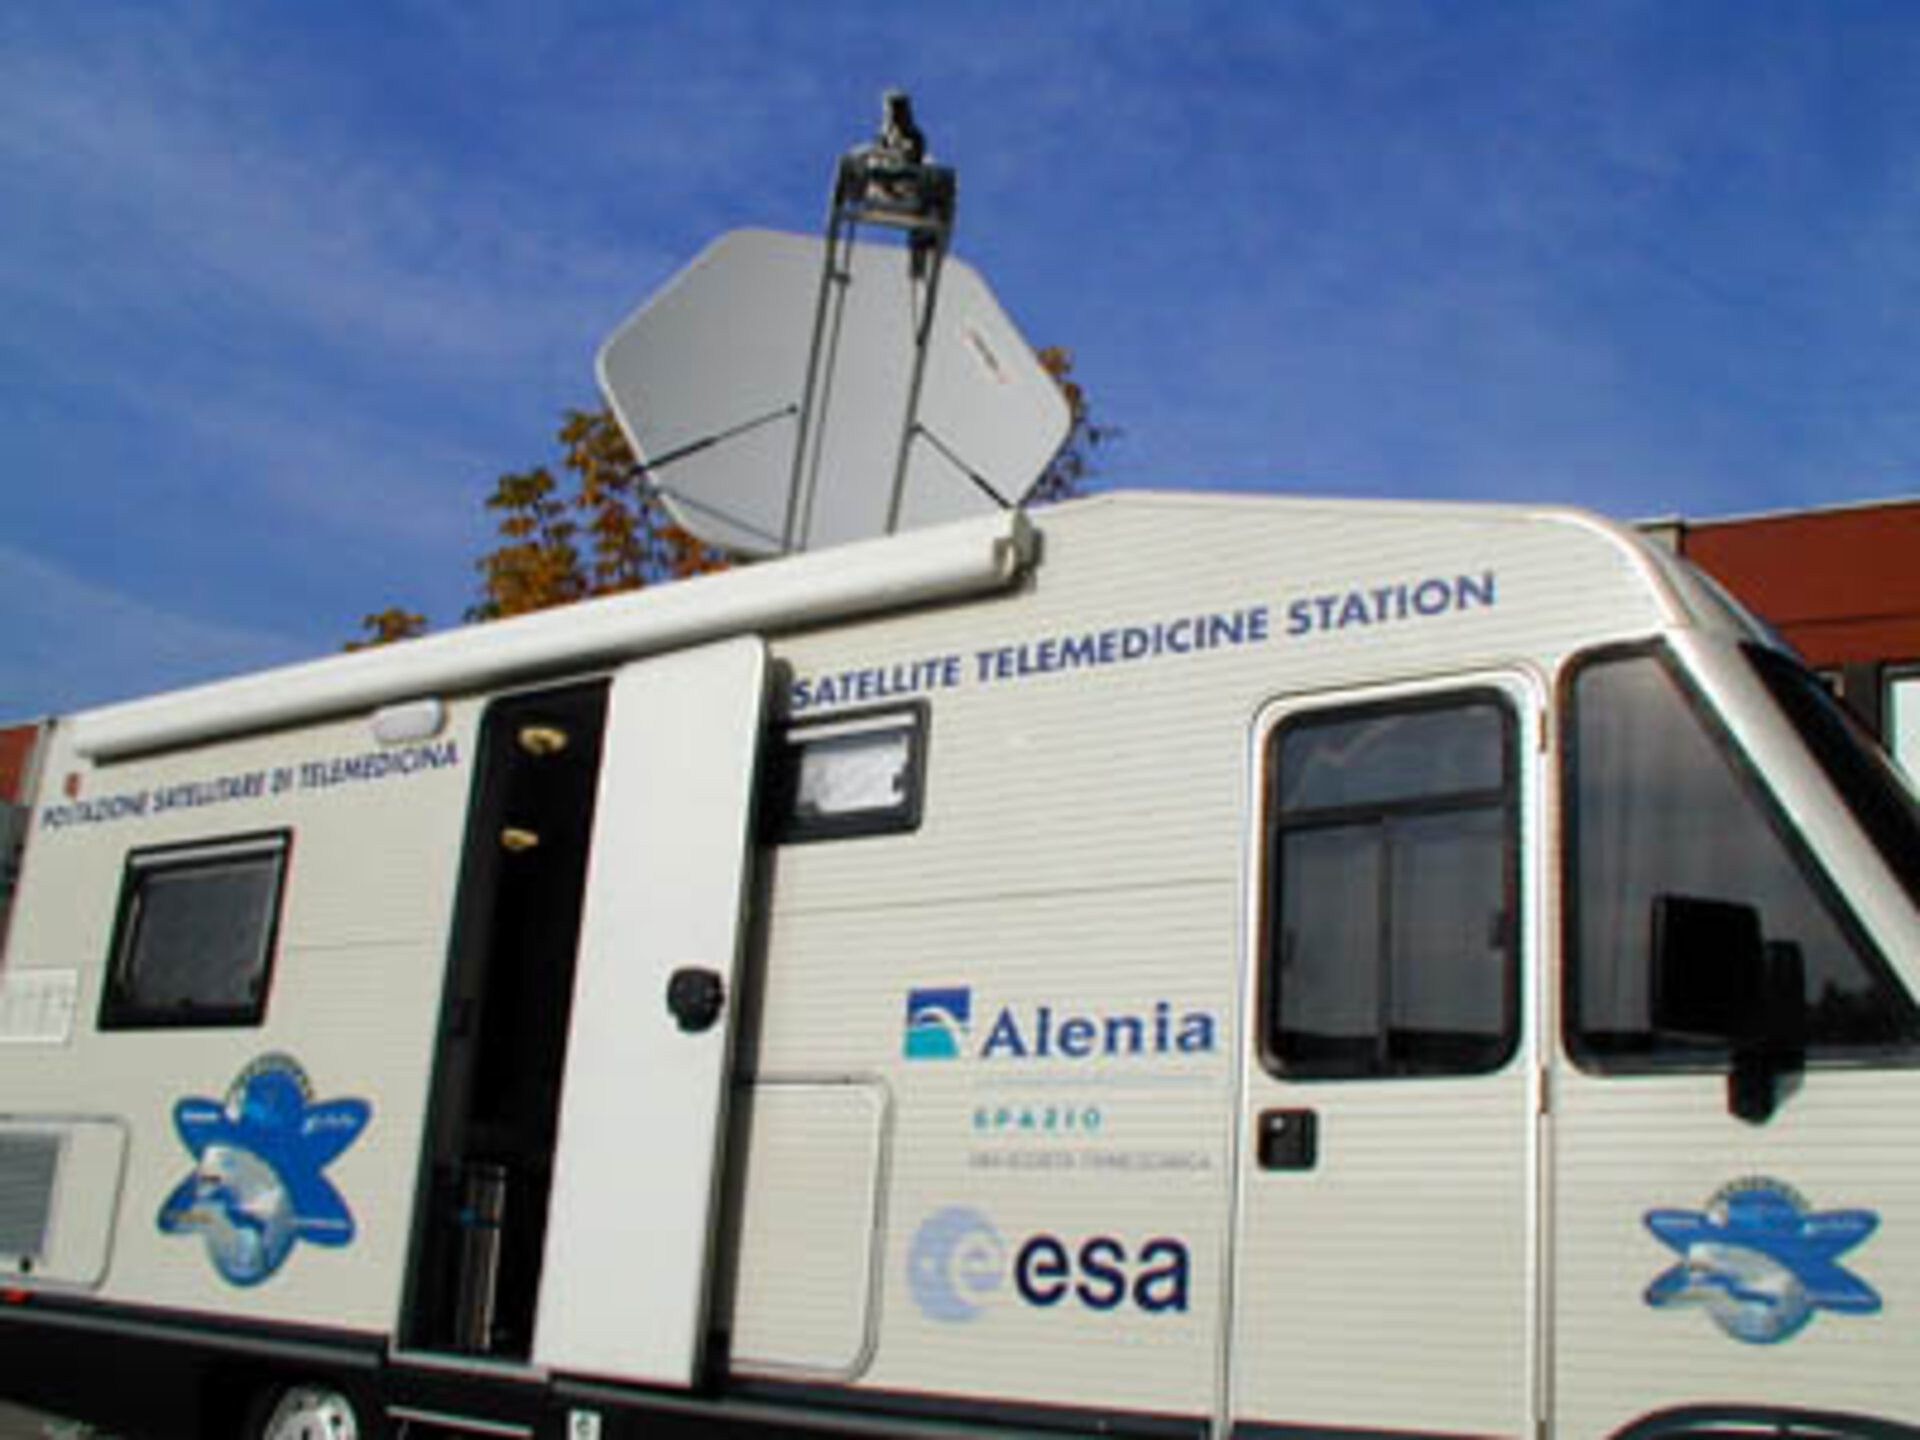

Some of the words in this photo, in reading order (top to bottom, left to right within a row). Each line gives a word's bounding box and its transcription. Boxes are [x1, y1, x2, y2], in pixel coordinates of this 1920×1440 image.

[789, 655, 961, 711] SATELLITE
[975, 607, 1269, 682] TELEMEDICINE
[1286, 571, 1497, 635] STATION
[301, 741, 460, 788] TELEMEDICINA
[979, 1001, 1217, 1058] Alenia
[1014, 1234, 1191, 1314] esa
